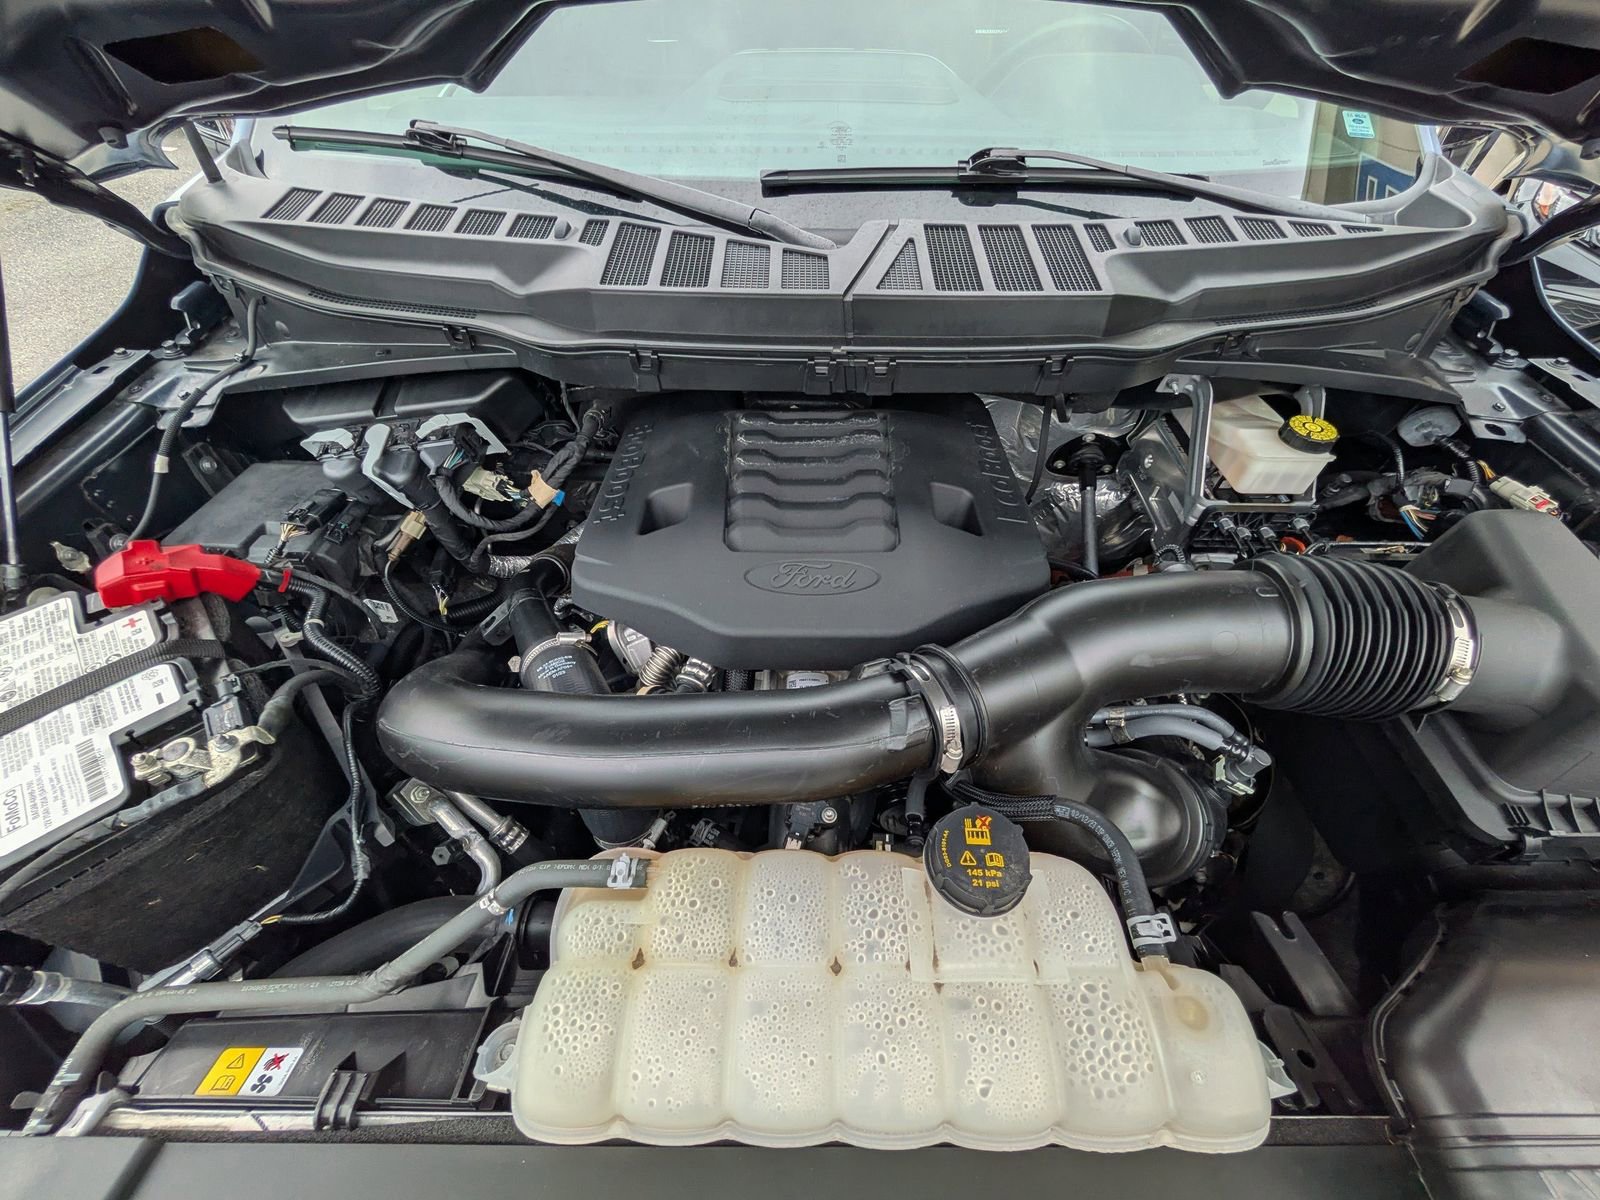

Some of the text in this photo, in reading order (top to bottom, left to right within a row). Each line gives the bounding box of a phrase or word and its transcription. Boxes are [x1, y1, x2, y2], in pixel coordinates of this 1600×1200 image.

[771, 562, 857, 588] Ford
[3, 789, 21, 833] FoMoCo
[966, 868, 1002, 878] 145 kPa
[971, 878, 1000, 888] 21 psi
